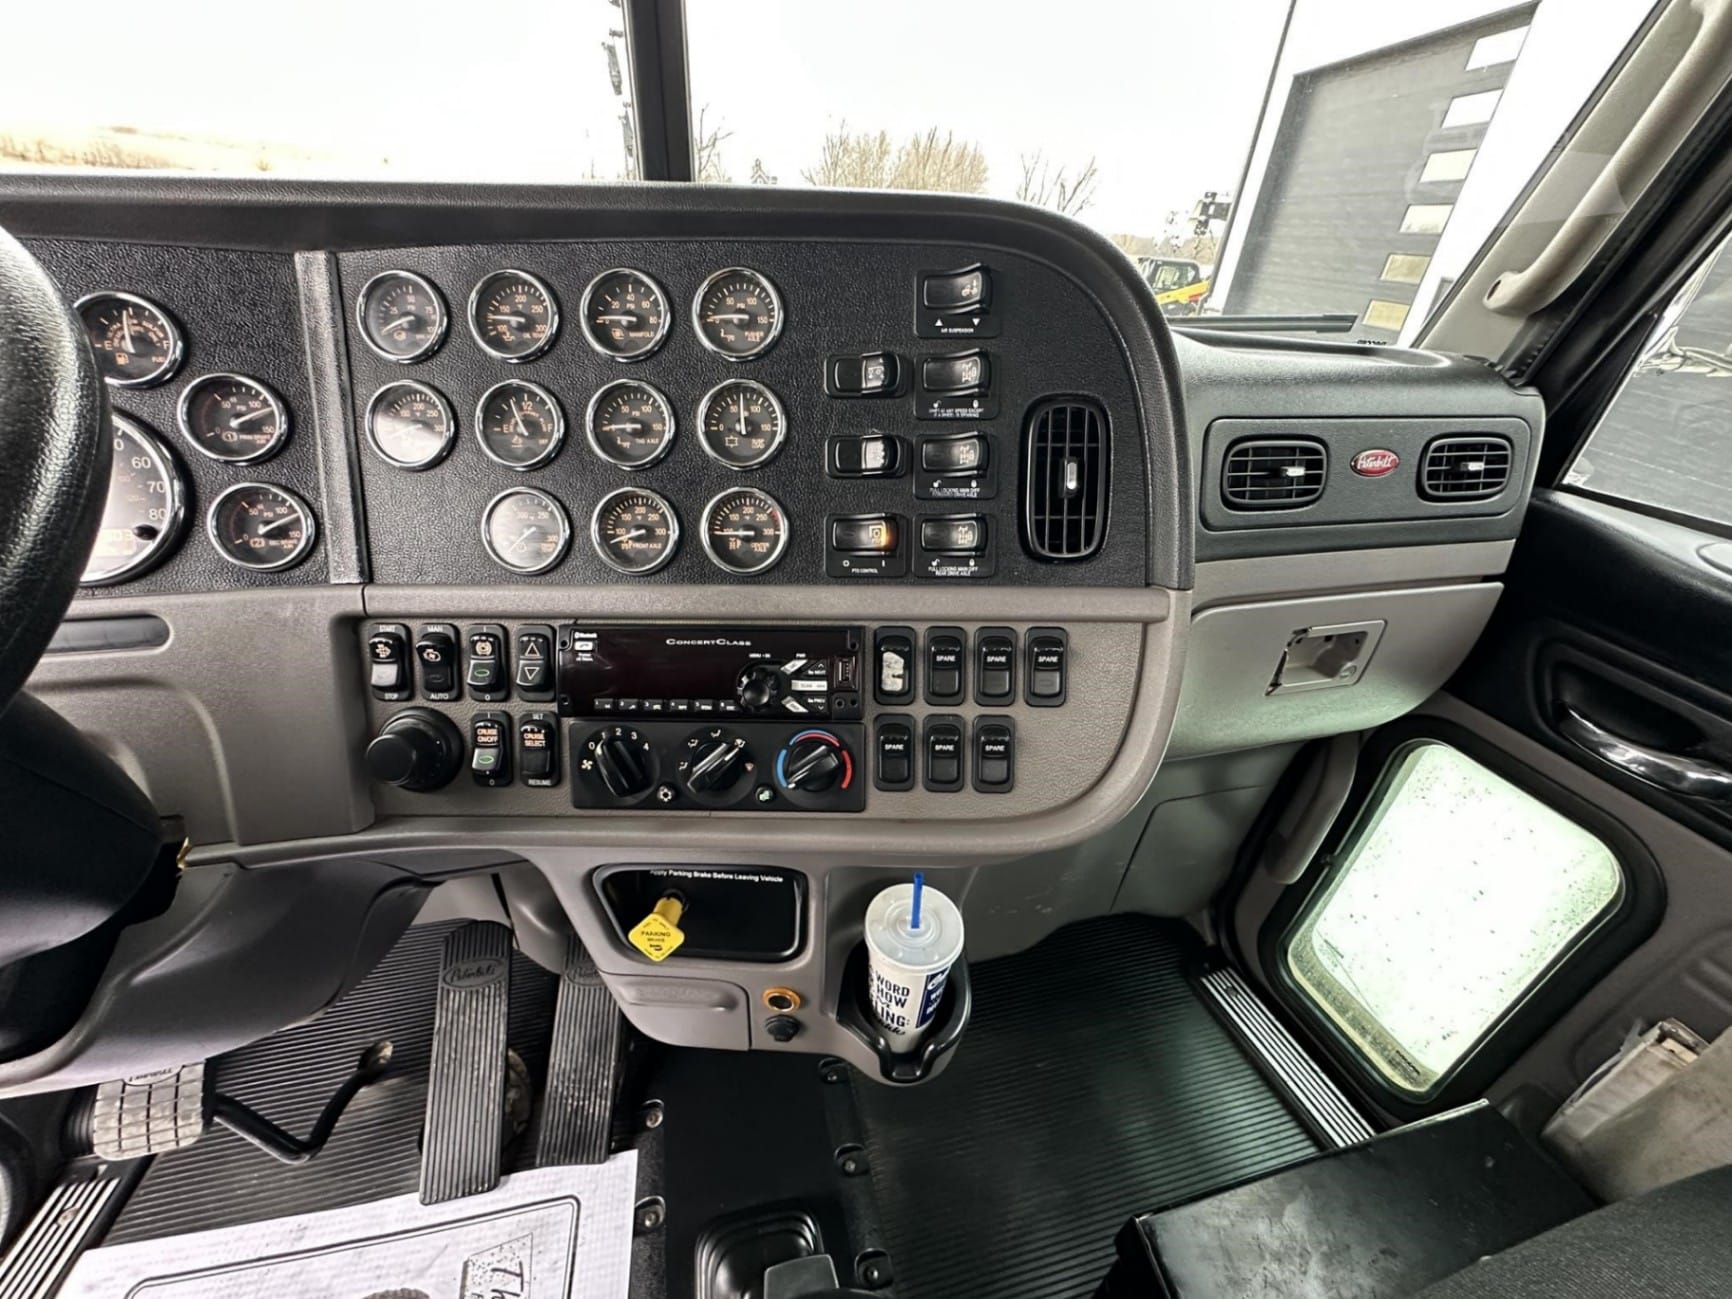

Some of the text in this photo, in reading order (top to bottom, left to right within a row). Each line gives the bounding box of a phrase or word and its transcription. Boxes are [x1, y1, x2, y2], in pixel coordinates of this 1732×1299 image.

[132, 456, 151, 469] 60
[147, 481, 166, 494] 70
[148, 508, 167, 521] 80
[936, 654, 956, 662] SPARE
[986, 655, 1006, 663] SPARE
[1038, 655, 1058, 663] SPARE
[615, 727, 622, 736] 2
[631, 731, 638, 740] 3
[588, 741, 596, 750] 0
[642, 742, 649, 751] 4
[668, 869, 692, 878] Parking
[734, 873, 759, 882] Leaving
[876, 970, 910, 997] WORD
